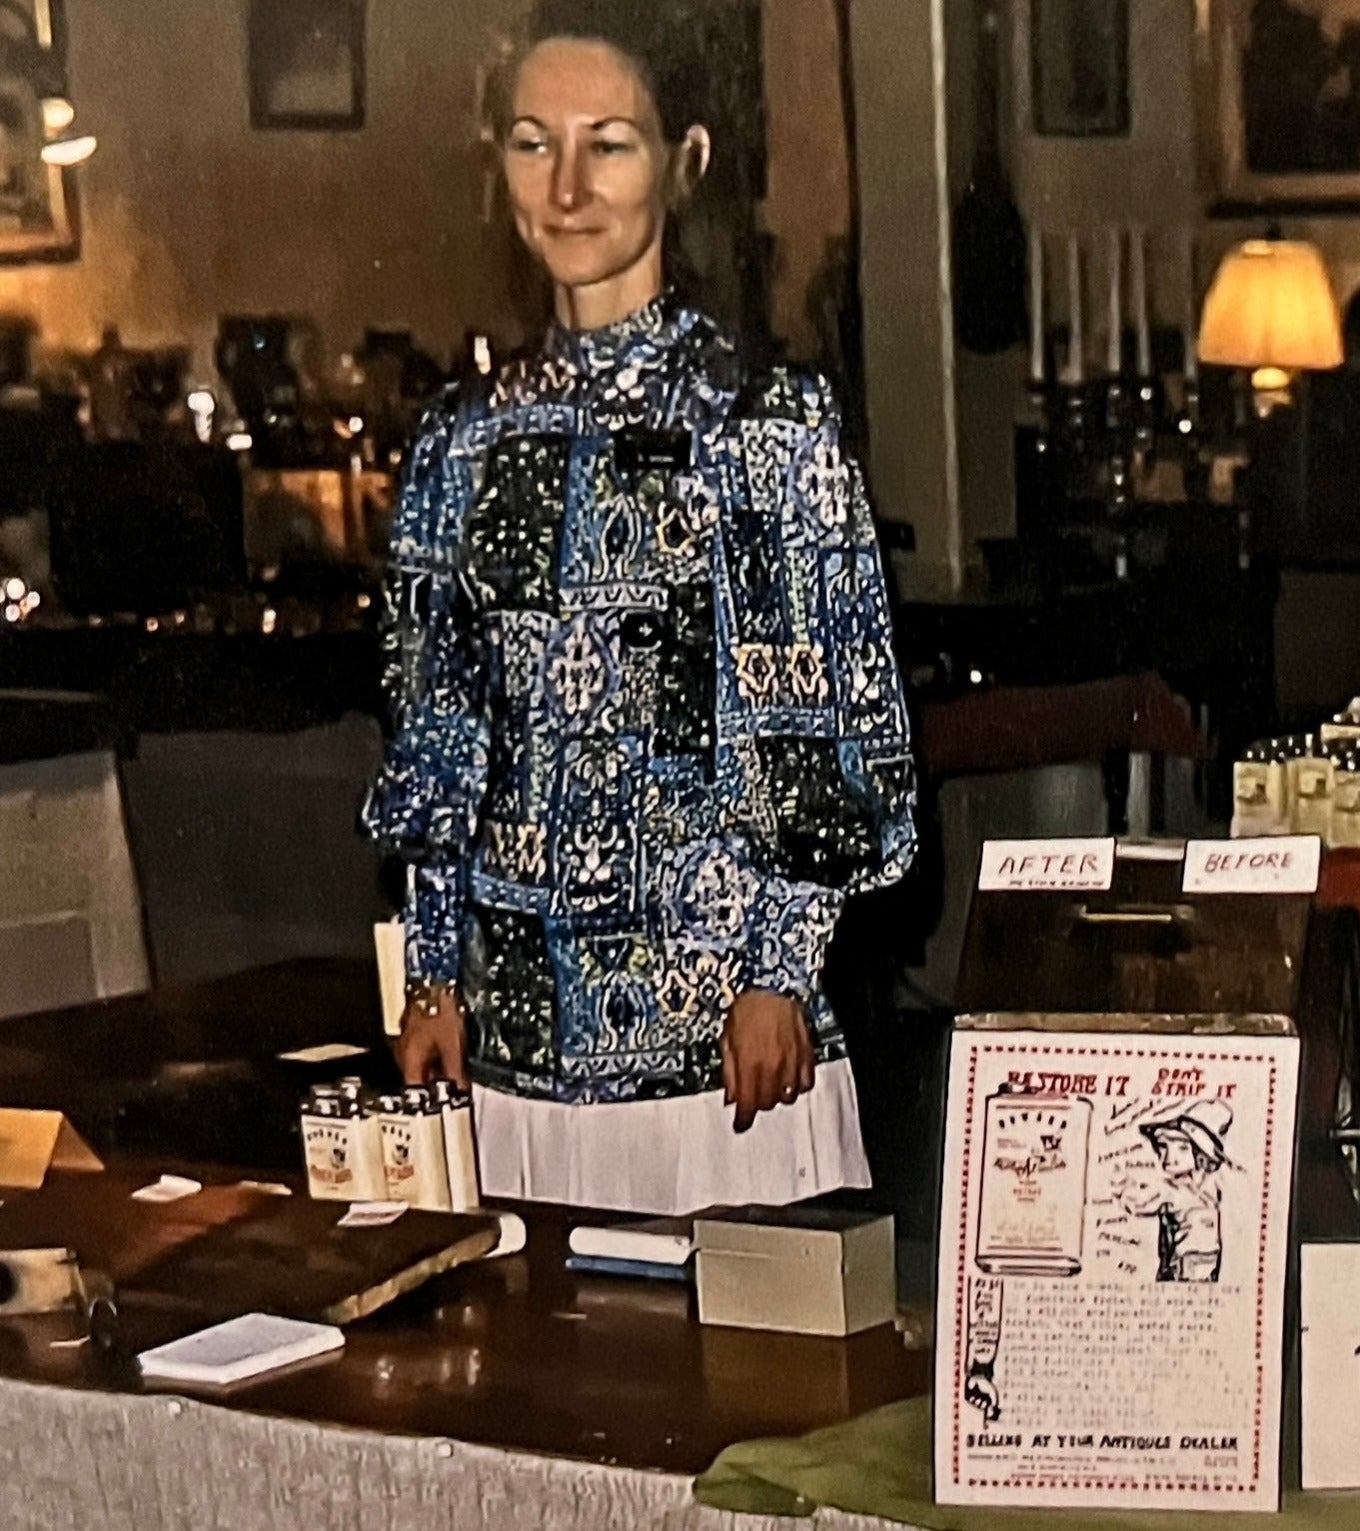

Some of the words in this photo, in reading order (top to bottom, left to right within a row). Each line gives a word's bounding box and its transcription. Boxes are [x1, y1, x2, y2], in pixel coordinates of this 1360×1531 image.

[998, 854, 1098, 874] AFTER
[1203, 853, 1293, 874] BEFORE
[1104, 1075, 1131, 1097] IT
[1216, 1083, 1238, 1099] IT
[1031, 1434, 1052, 1449] AT
